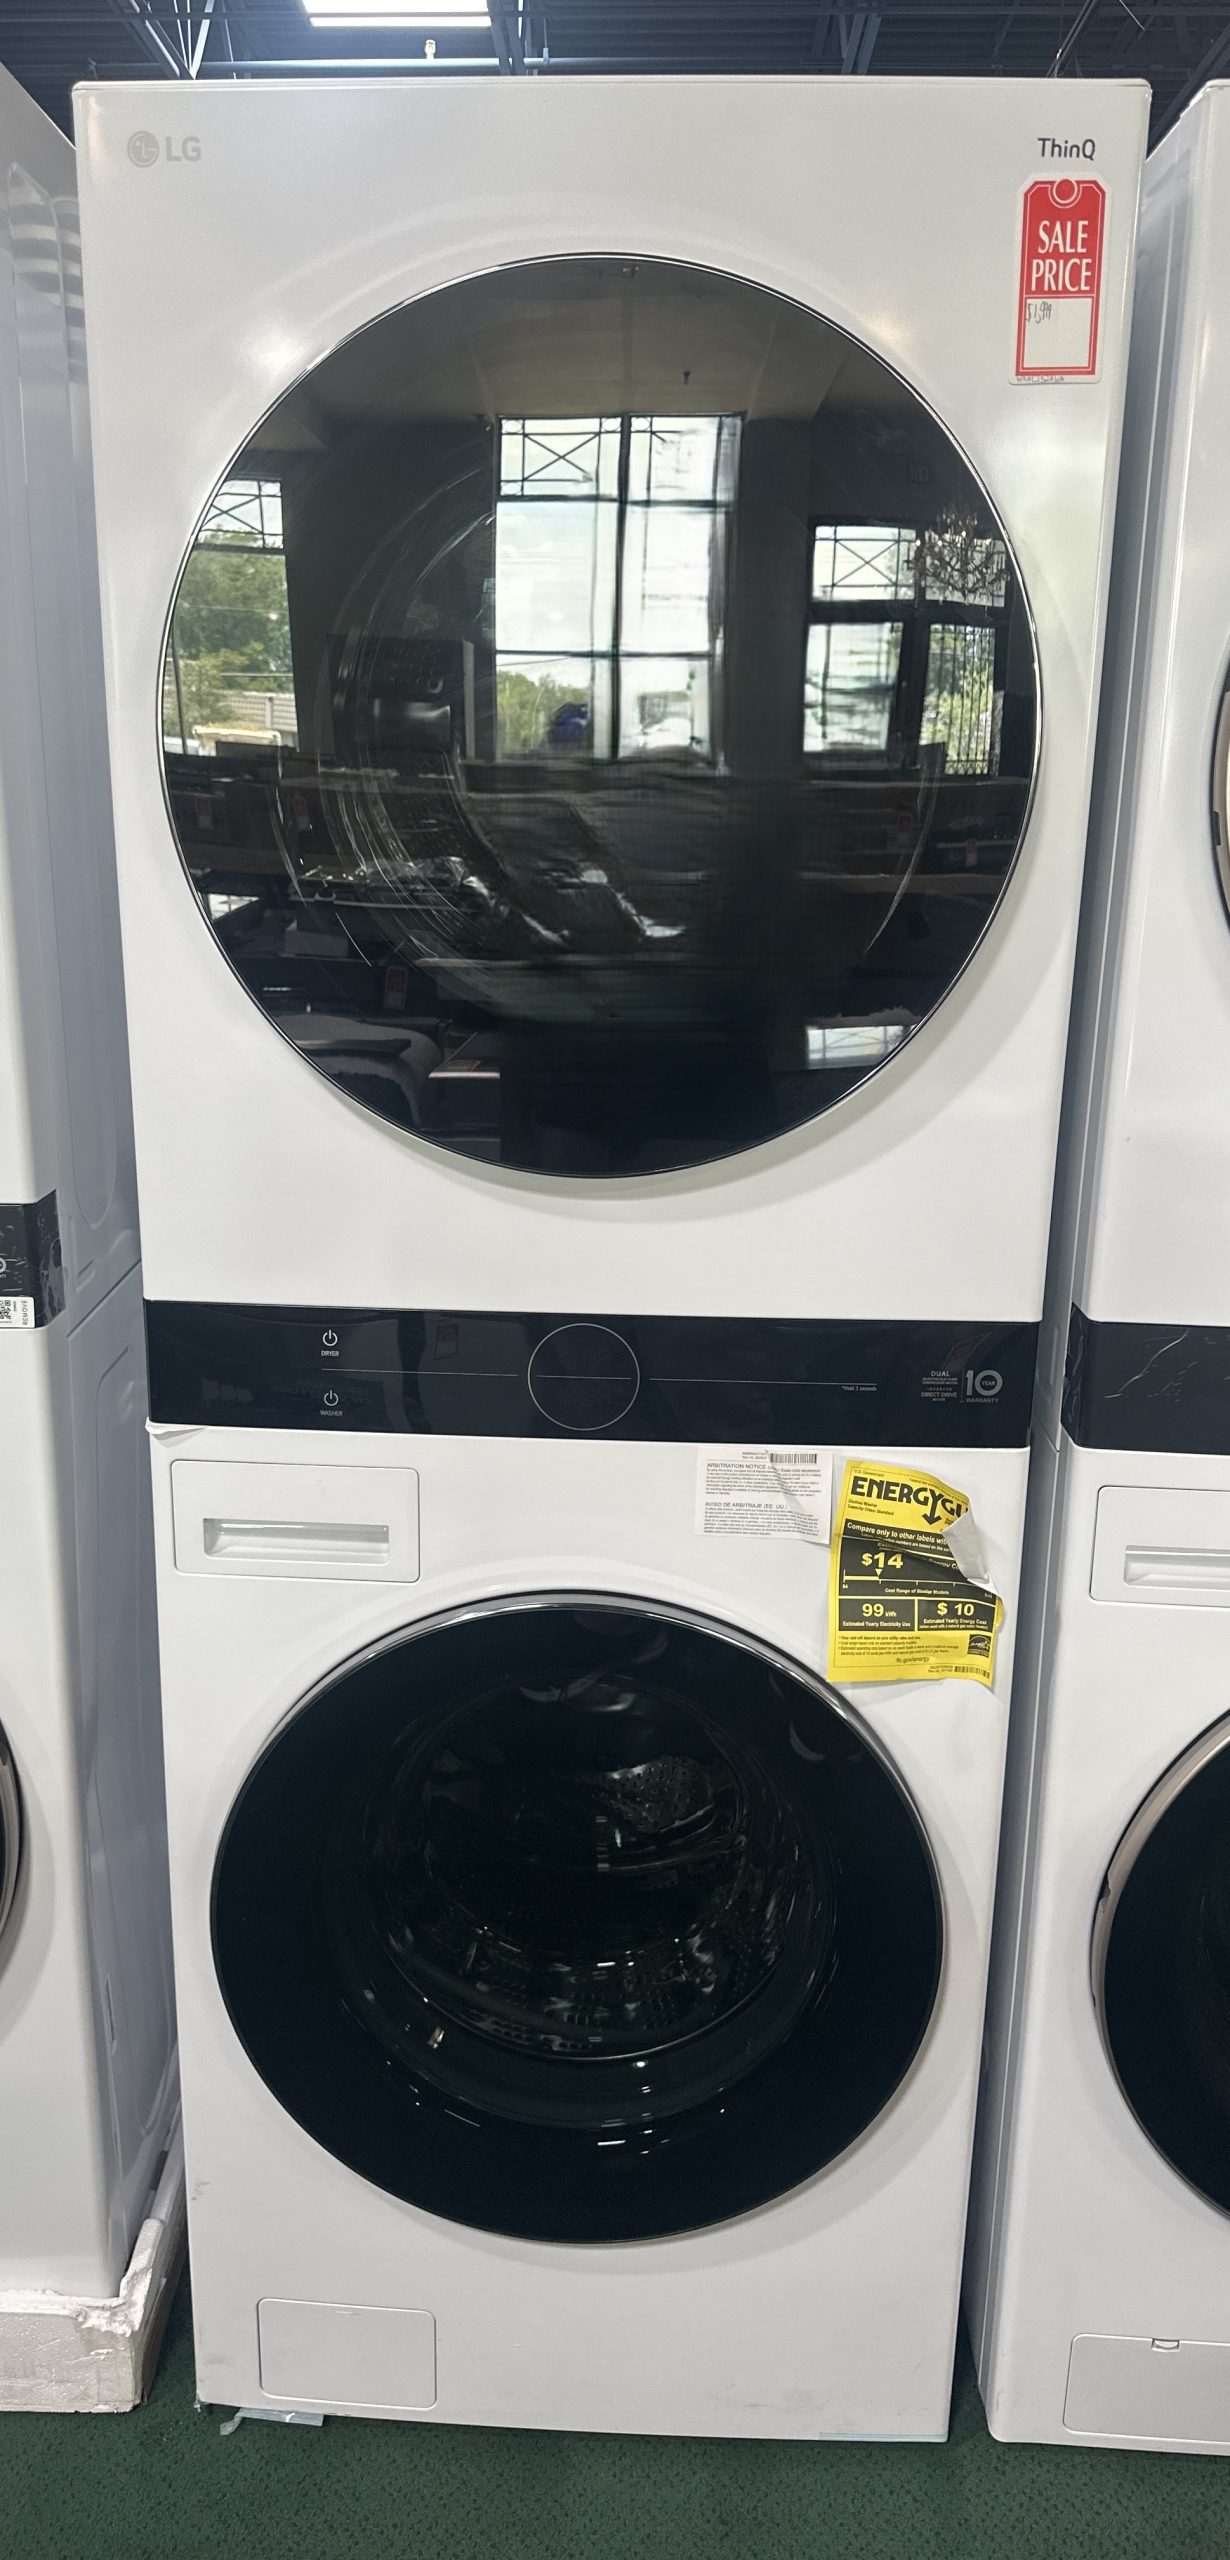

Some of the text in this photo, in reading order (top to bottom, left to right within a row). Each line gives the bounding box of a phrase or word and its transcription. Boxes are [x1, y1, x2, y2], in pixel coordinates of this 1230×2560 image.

[166, 136, 201, 161] LG
[1038, 137, 1096, 161] ThinQ
[1038, 220, 1089, 254] SALE
[1031, 258, 1092, 292] PRICE
[966, 1370, 1003, 1396] 10
[877, 1508, 894, 1516] Standard
[847, 1522, 875, 1534] Compare
[877, 1529, 890, 1538] only
[891, 1530, 898, 1538] to
[899, 1532, 915, 1540] other
[917, 1534, 935, 1543] labels
[862, 1552, 904, 1569] $14
[862, 1604, 884, 1617] 99
[937, 1602, 974, 1616] $ 10
